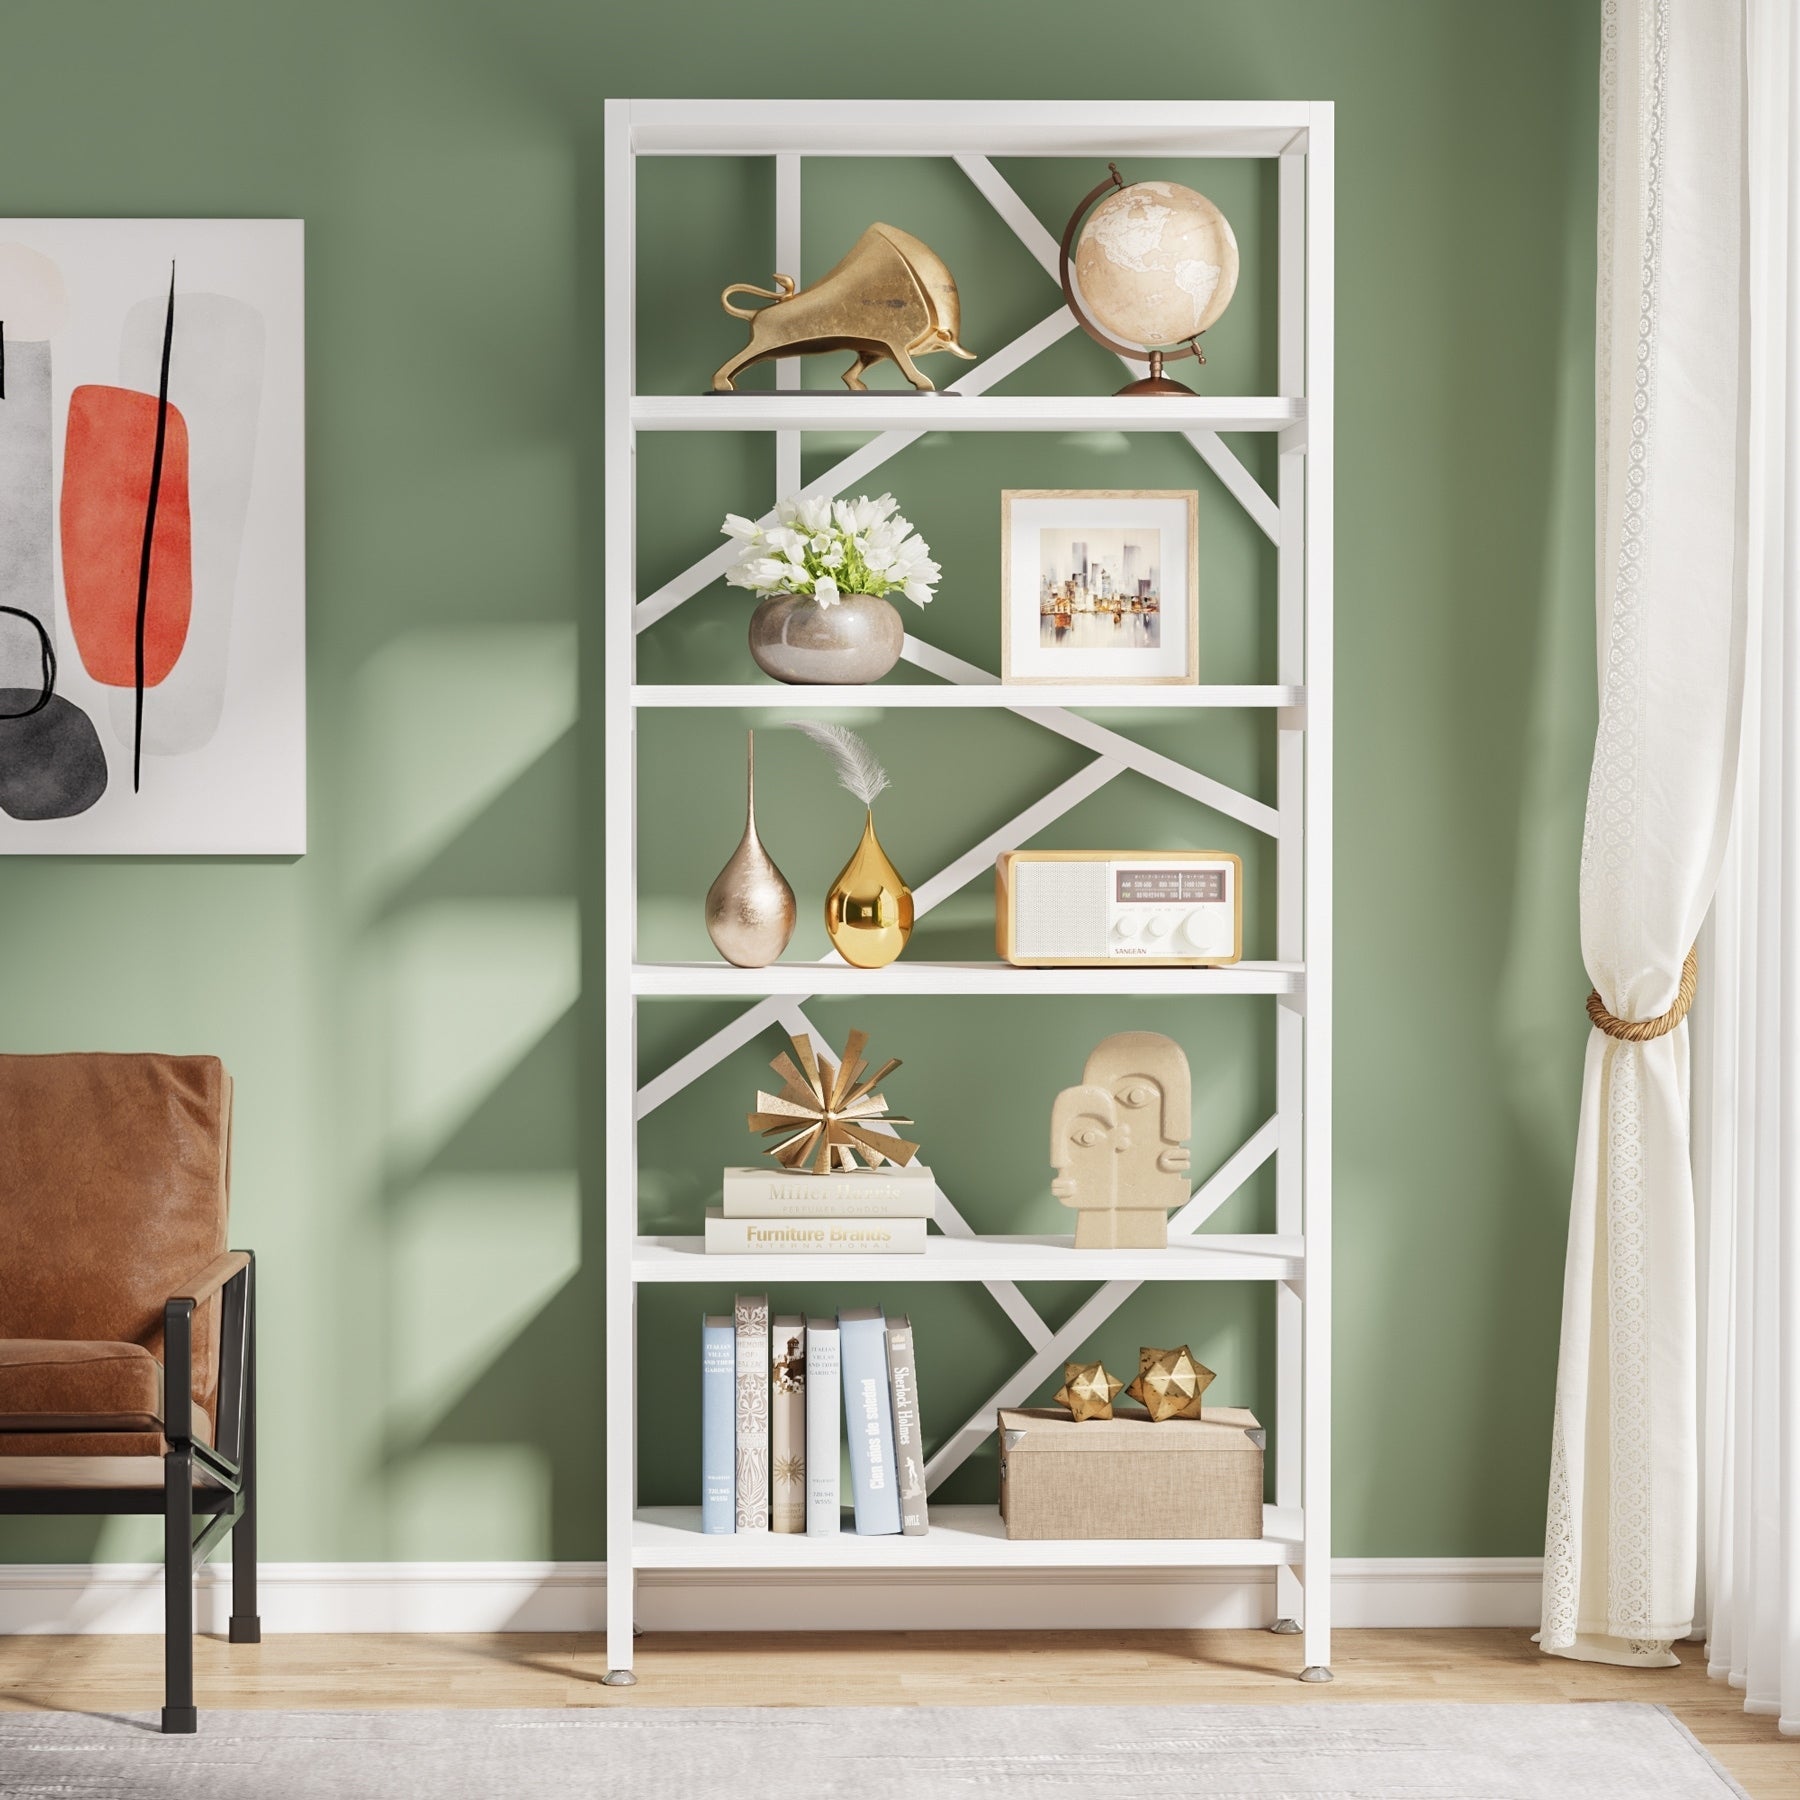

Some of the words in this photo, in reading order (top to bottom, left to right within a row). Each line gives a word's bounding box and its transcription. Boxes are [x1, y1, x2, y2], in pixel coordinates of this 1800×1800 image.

[768, 1183, 828, 1201] Miller
[842, 1205, 888, 1213] LONDON
[746, 1225, 825, 1241] Furniture
[829, 1225, 892, 1241] Brands
[861, 1378, 878, 1419] soledad
[893, 1367, 911, 1408] Sherlock
[867, 1422, 881, 1436] de
[897, 1409, 915, 1446] Holmes
[868, 1437, 882, 1463] años
[869, 1464, 885, 1490] Cien
